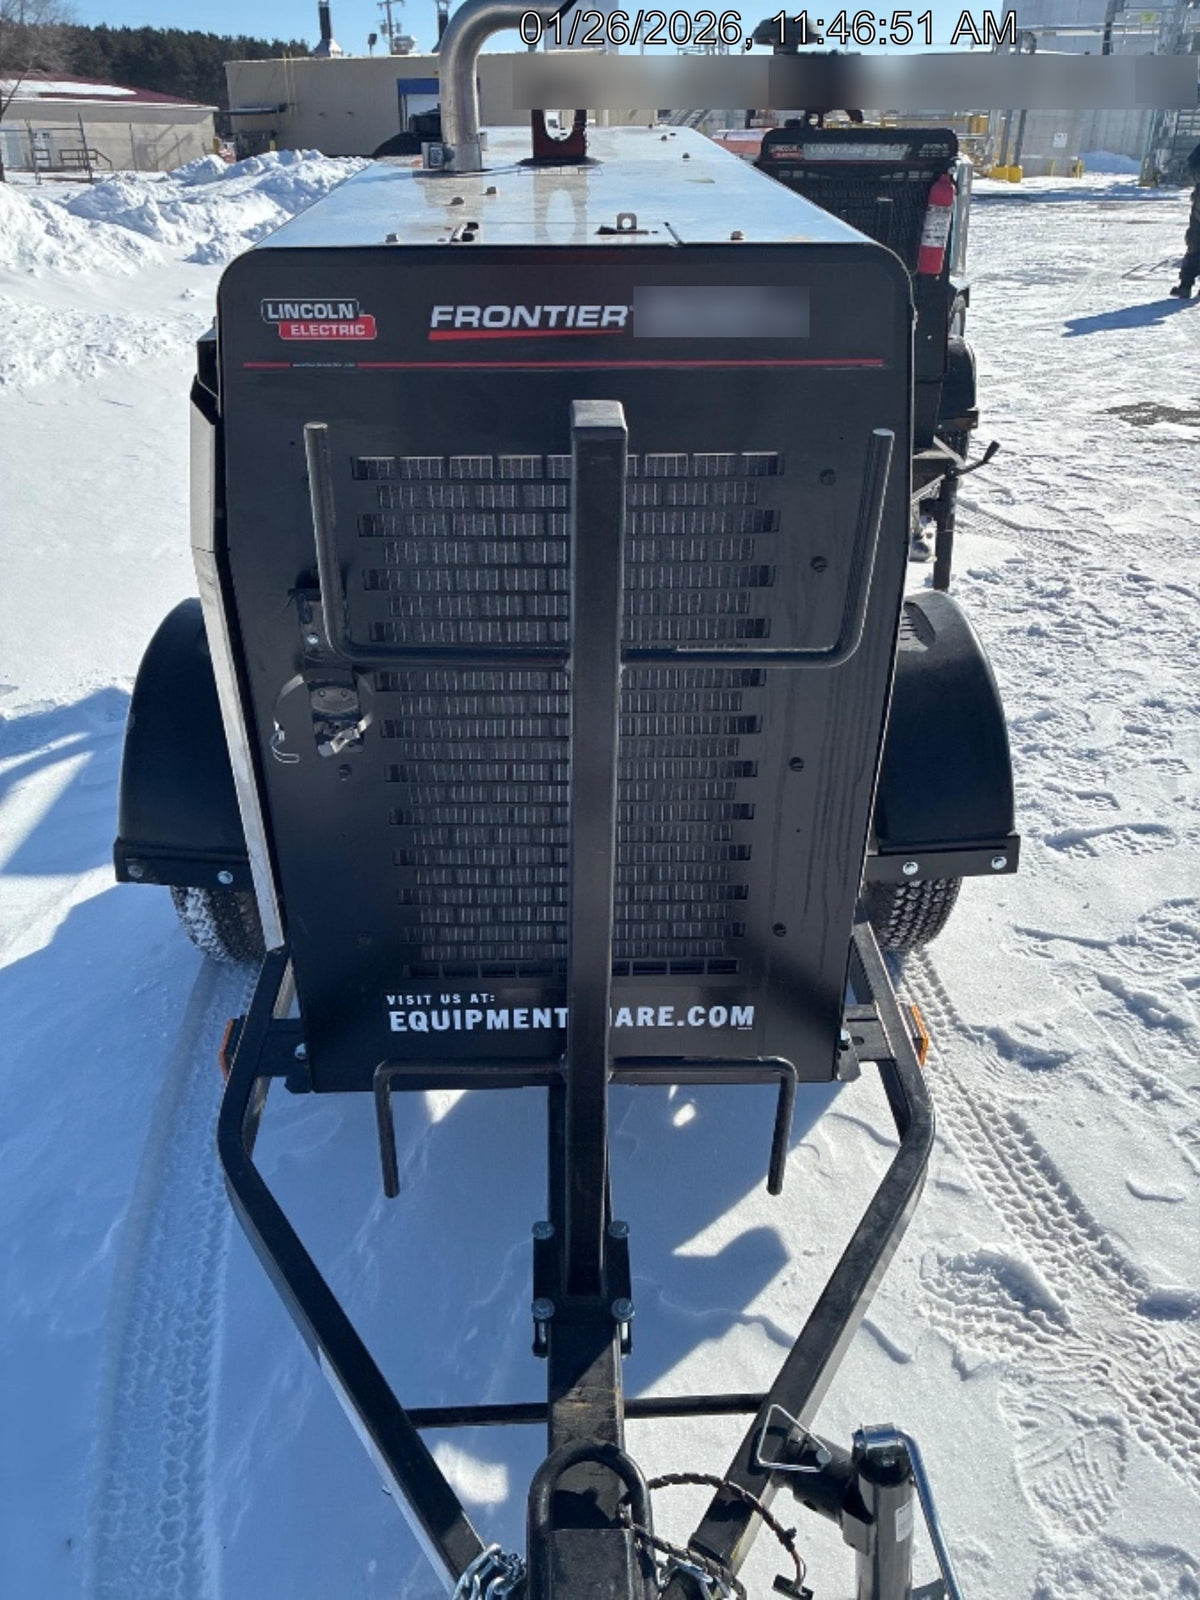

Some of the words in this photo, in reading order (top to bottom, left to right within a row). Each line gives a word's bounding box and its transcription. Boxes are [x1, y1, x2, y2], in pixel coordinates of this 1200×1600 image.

[267, 303, 354, 319] LINCOLN
[430, 305, 629, 328] FRONTIER
[291, 324, 366, 336] ELECTRIC
[386, 995, 432, 1005] VISIT
[440, 993, 461, 1005] US
[470, 993, 496, 1004] AT:
[389, 1006, 755, 1033] EQUIPMENTARE.COM
